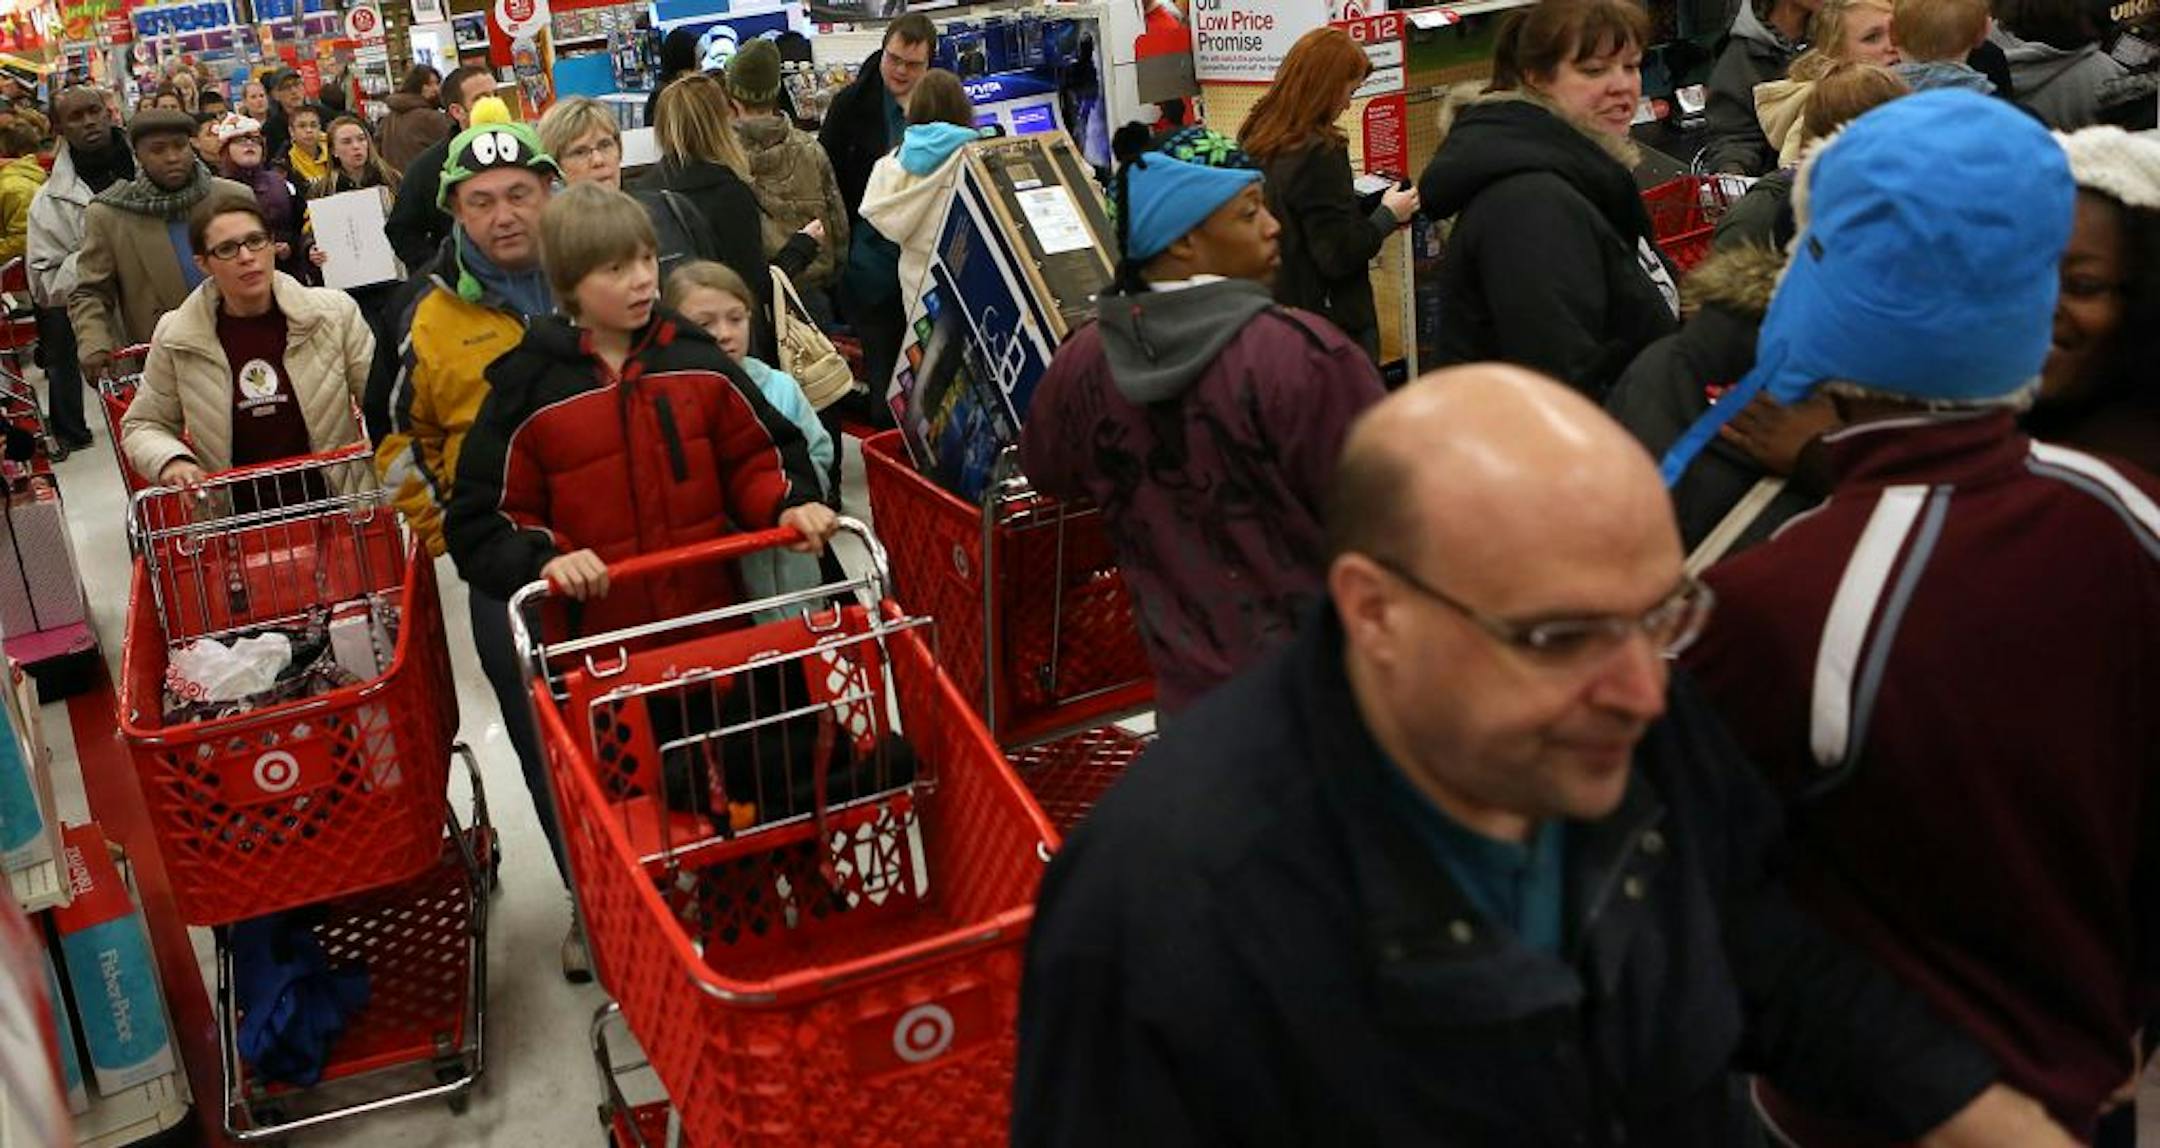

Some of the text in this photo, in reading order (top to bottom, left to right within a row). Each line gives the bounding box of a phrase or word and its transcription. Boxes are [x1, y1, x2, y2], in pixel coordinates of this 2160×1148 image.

[1197, 9, 1273, 31] Low Price
[1198, 31, 1262, 52] Promise
